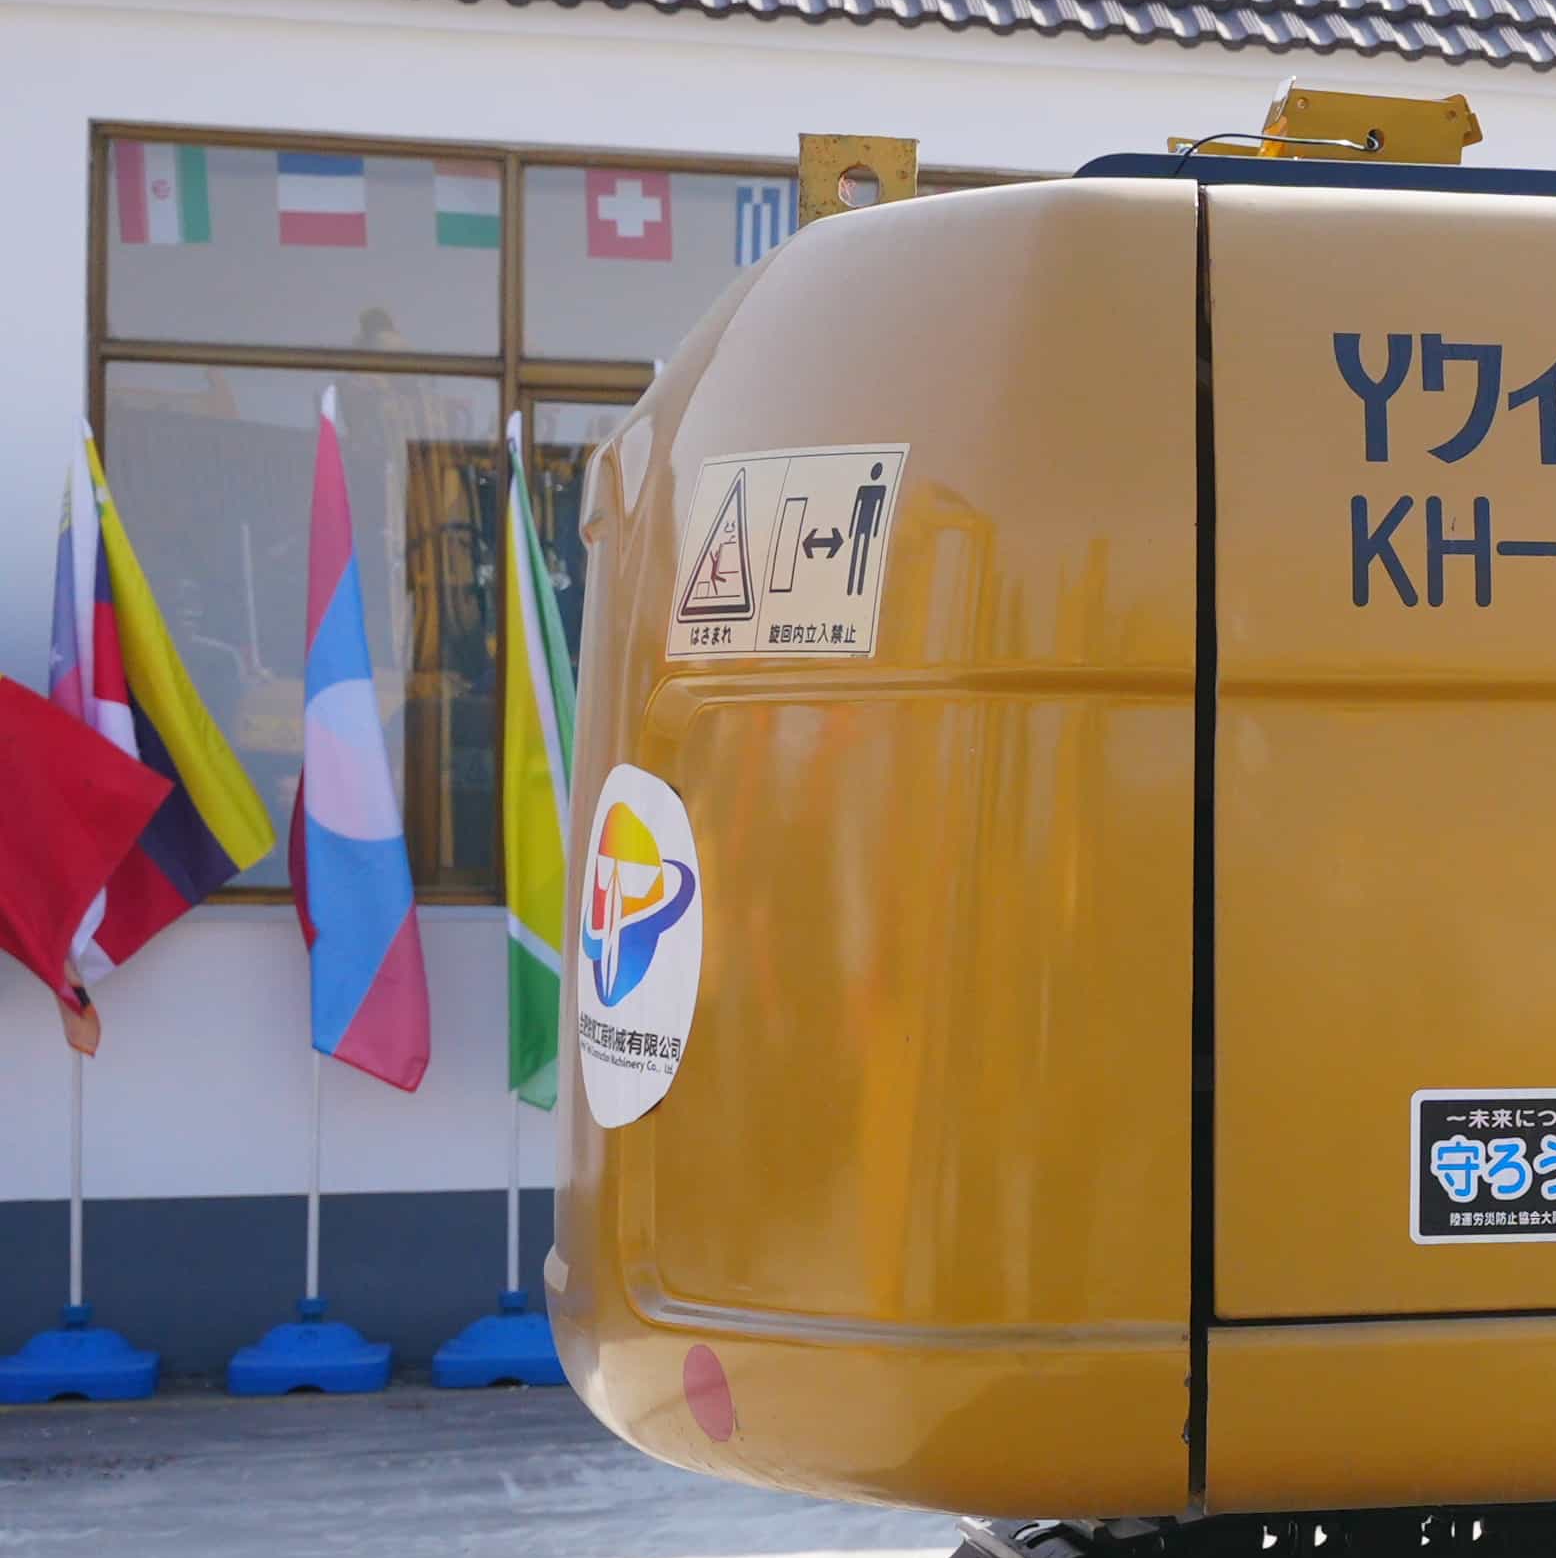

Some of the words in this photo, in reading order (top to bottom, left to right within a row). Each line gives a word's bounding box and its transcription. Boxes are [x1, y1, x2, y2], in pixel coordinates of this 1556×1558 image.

[690, 625, 732, 645] はさまれ
[769, 624, 857, 644] 旋回内立入禁止
